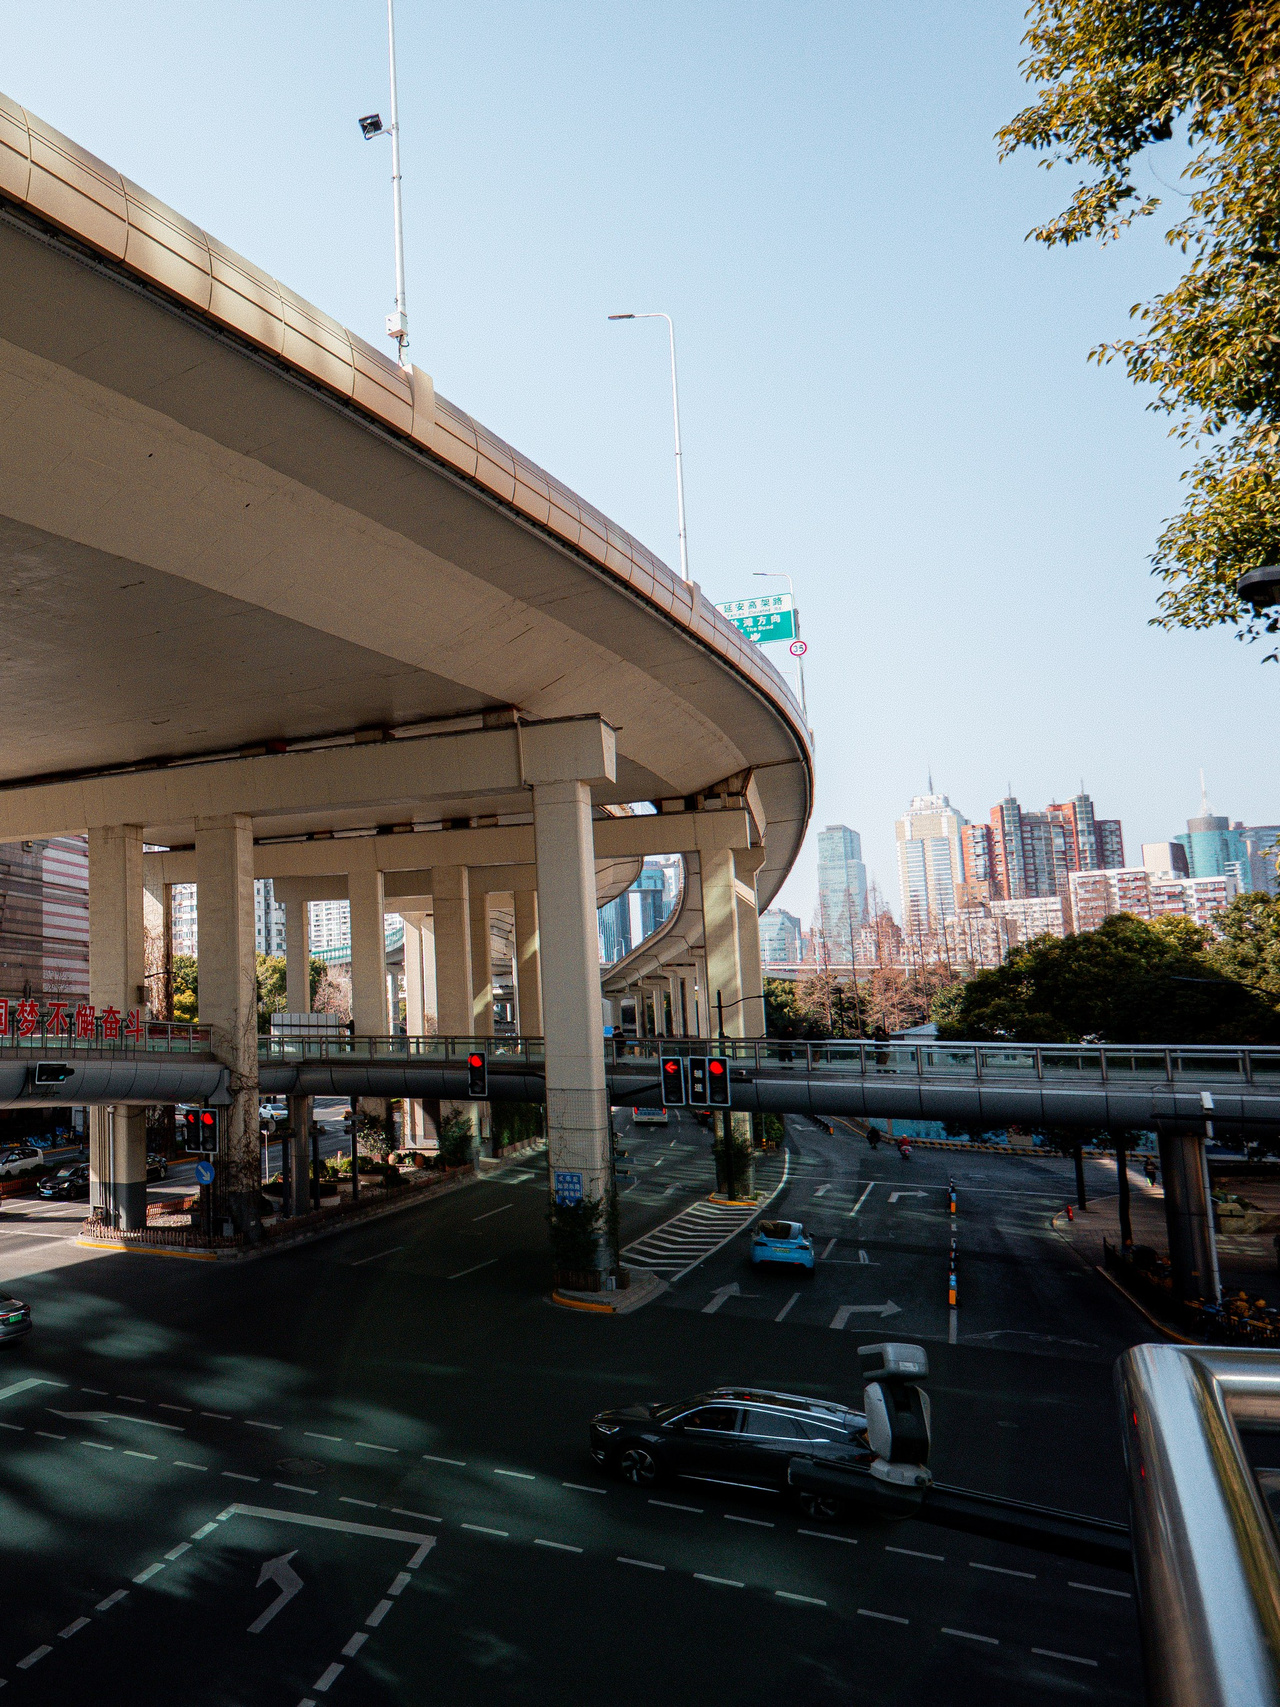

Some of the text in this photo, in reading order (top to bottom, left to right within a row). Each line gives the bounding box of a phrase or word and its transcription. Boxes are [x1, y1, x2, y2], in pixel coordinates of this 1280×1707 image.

[724, 597, 782, 613] 延安高架路
[793, 644, 804, 653] 35
